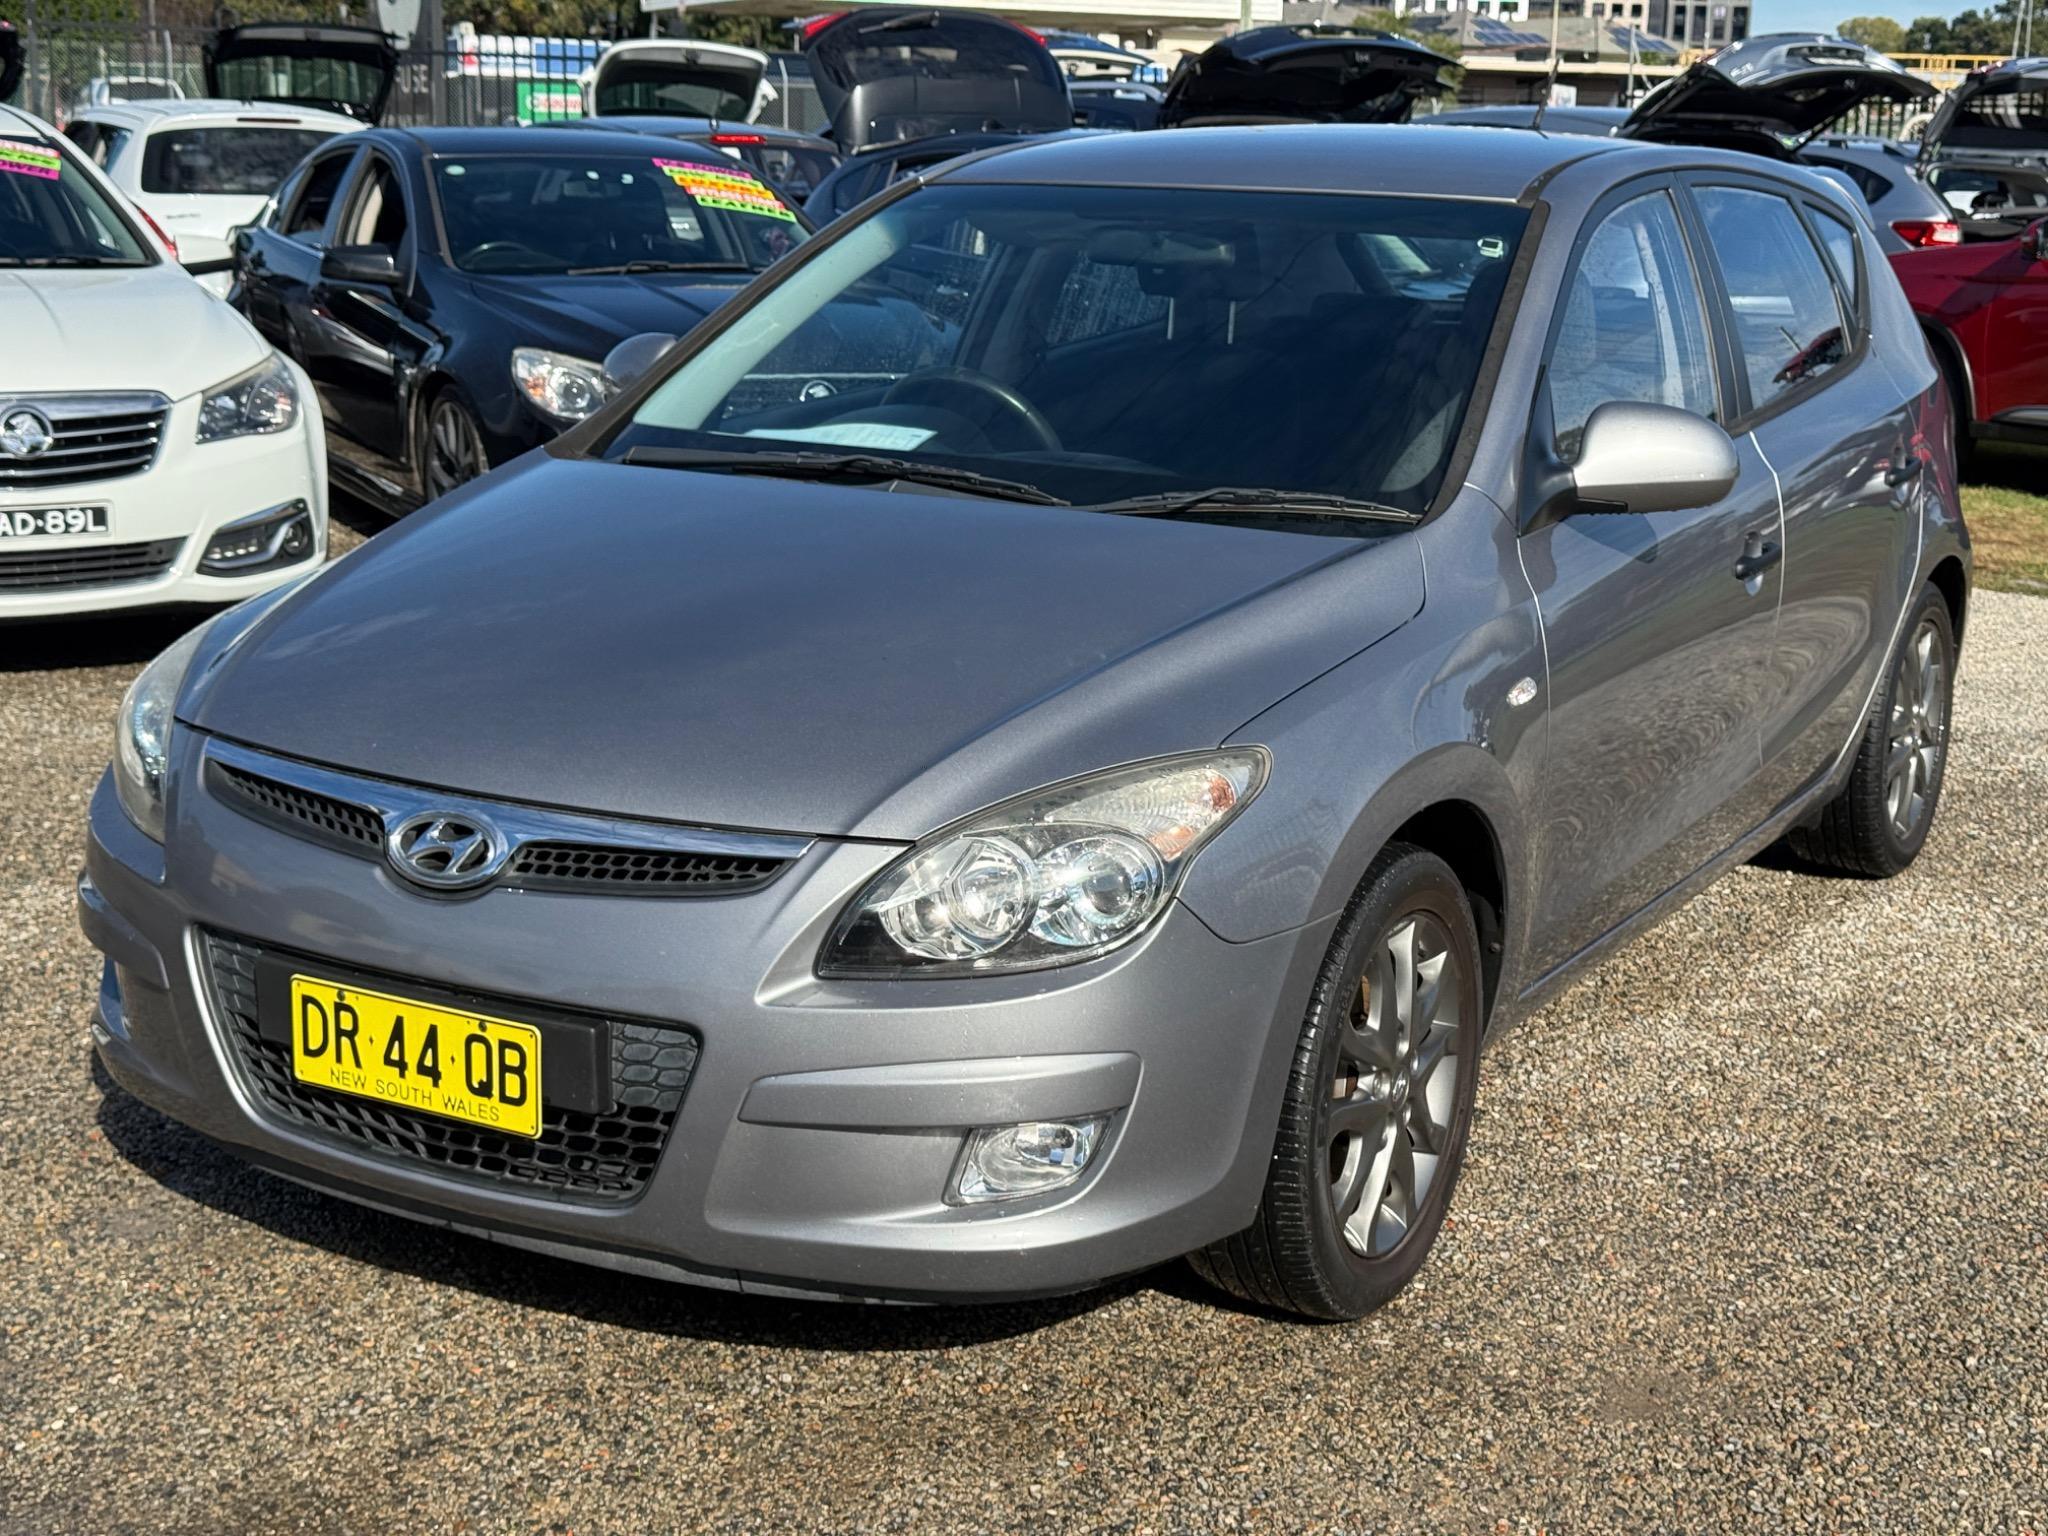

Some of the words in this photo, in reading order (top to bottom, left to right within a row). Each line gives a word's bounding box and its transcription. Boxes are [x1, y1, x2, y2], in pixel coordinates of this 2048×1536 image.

[700, 196, 791, 218] LEATHER
[330, 1066, 367, 1090] NEW
[375, 1079, 433, 1106] SOUTH
[442, 1095, 500, 1122] WALES
